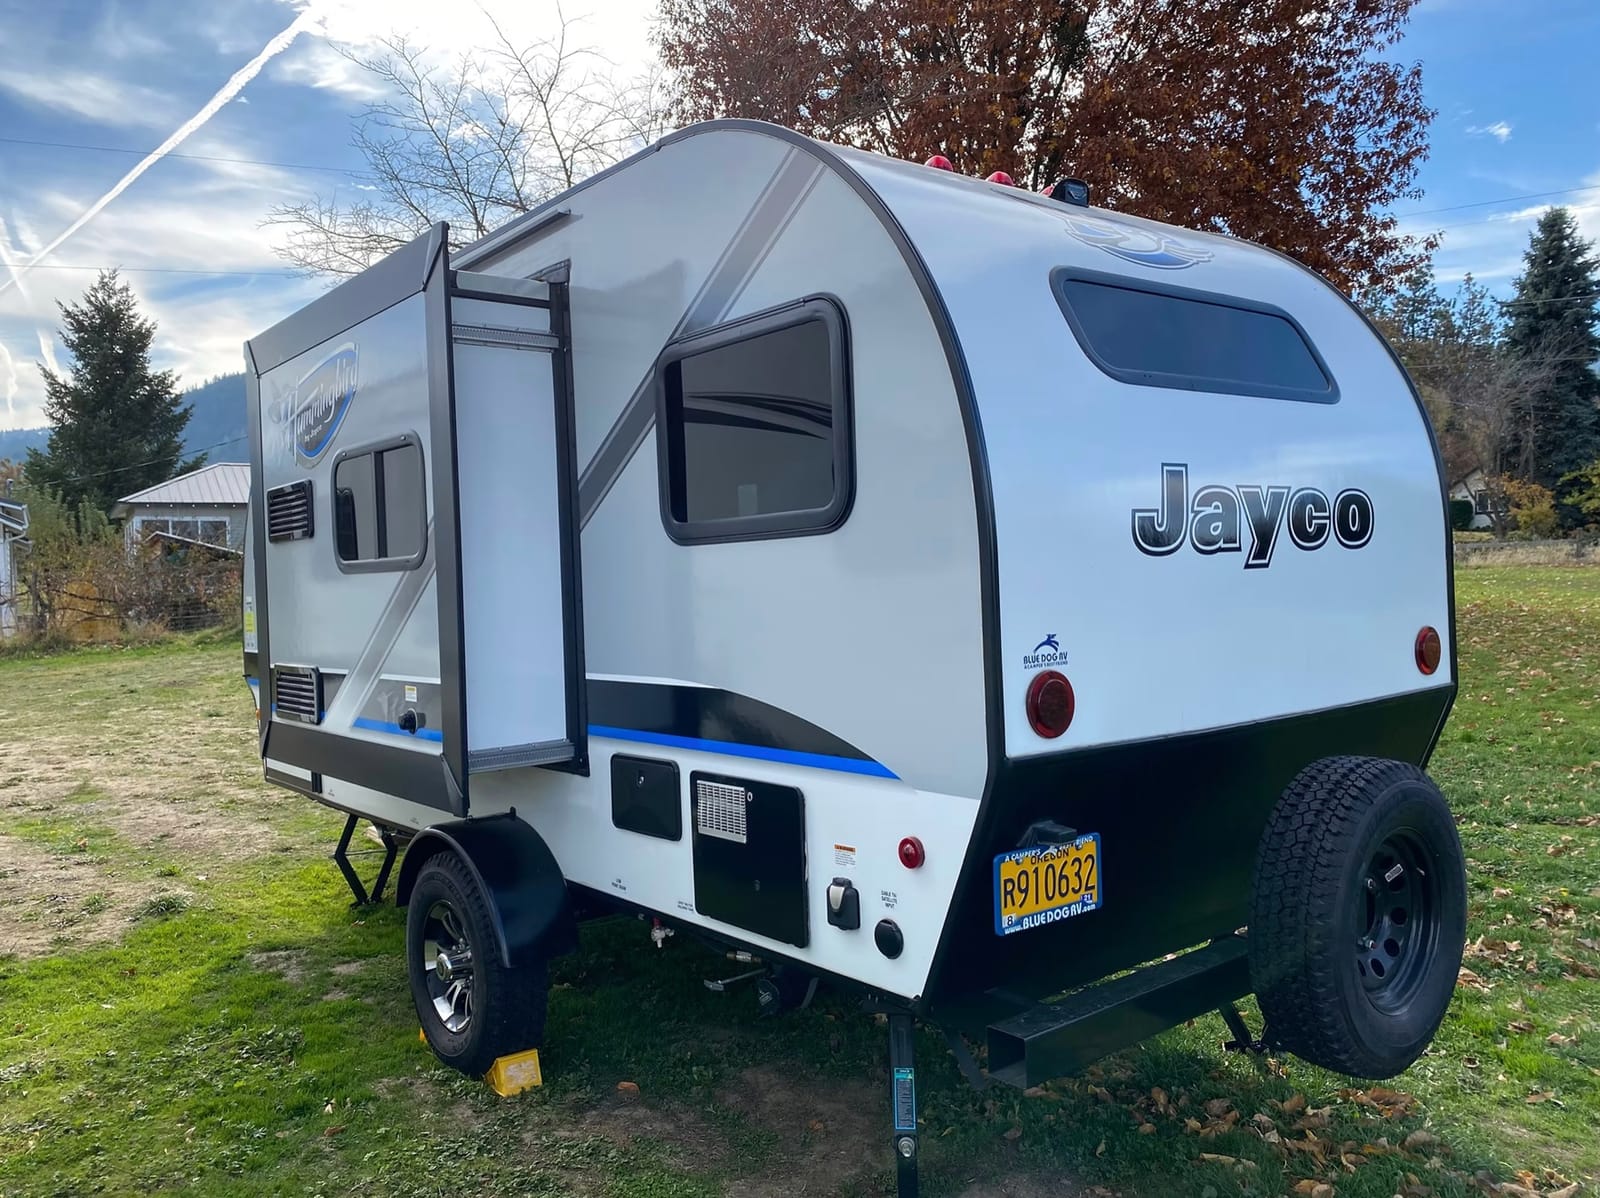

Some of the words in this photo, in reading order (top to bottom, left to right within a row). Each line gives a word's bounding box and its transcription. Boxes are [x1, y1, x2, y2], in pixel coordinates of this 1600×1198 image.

[1131, 462, 1375, 570] Jayco
[1023, 655, 1040, 664] BLUE
[1041, 653, 1058, 662] DOG
[1059, 651, 1068, 661] RV
[1005, 855, 1010, 863] A
[1011, 848, 1041, 861] CAMPER'S
[1030, 848, 1070, 865] OREGON
[1003, 854, 1096, 909] R910632
[1007, 916, 1014, 926] 8
